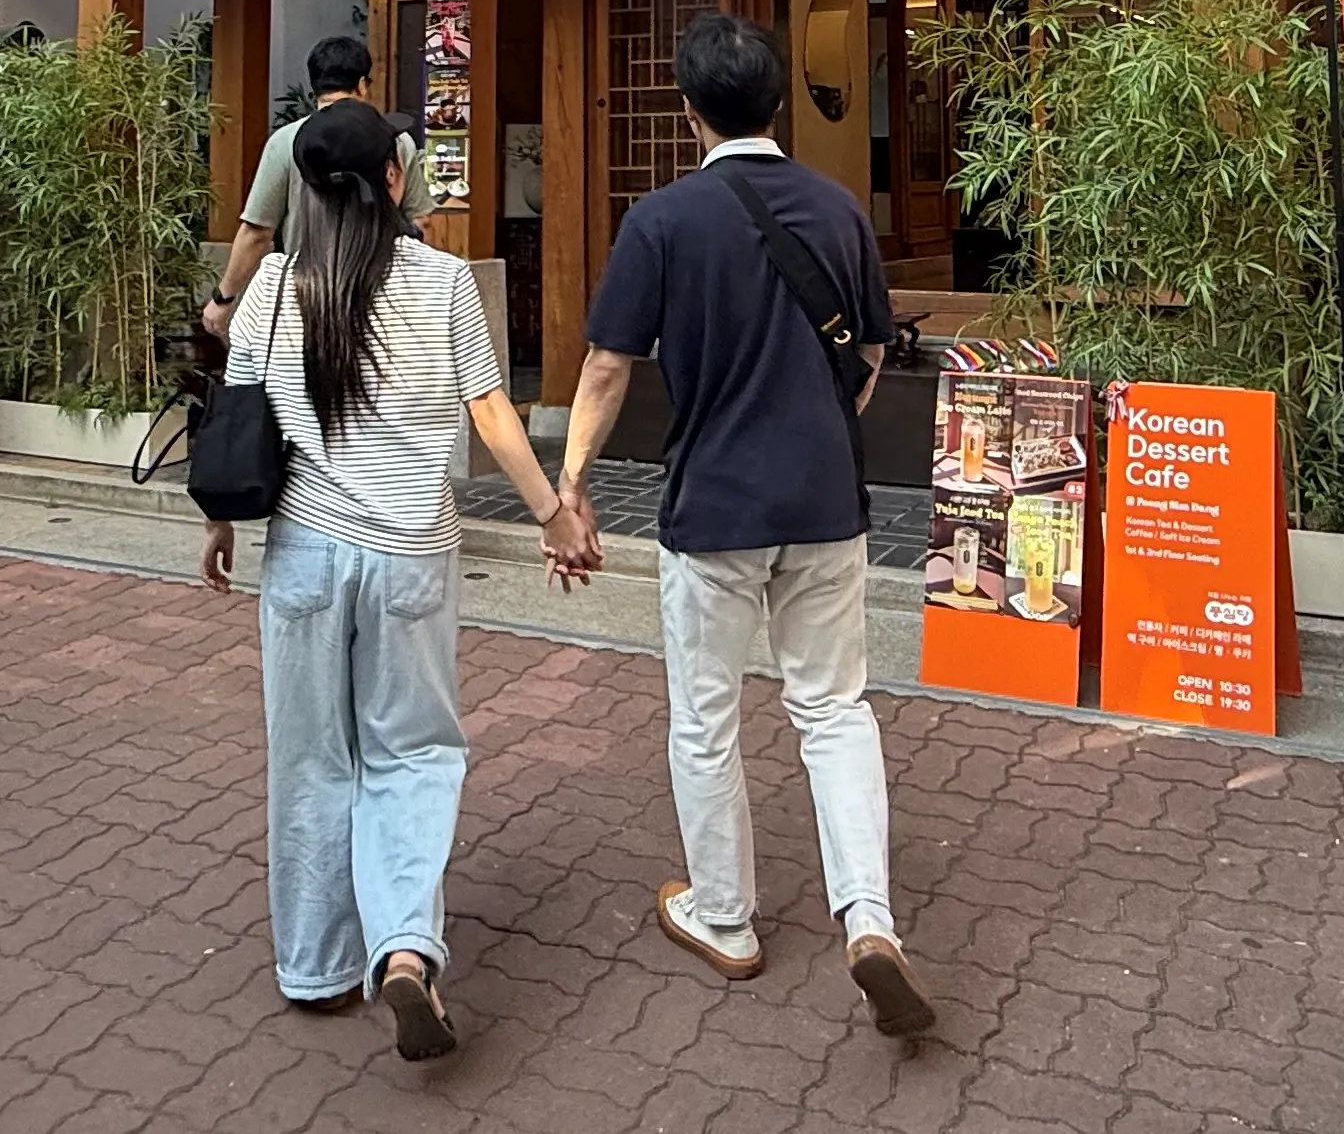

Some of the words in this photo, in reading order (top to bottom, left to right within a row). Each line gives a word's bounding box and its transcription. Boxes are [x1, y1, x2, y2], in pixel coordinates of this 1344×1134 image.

[1128, 407, 1225, 437] Korean
[1127, 434, 1230, 466] Dessert
[1125, 461, 1191, 490] Cafe
[985, 508, 1005, 521] Tea
[1125, 516, 1156, 527] Korean
[1156, 517, 1172, 529] Tea
[1173, 520, 1180, 529] &
[1181, 521, 1214, 533] Dessert
[1125, 527, 1154, 539] Coffee
[1160, 530, 1178, 542] Soft
[1192, 534, 1221, 546] Cream
[1209, 605, 1250, 622] 풍심당
[1162, 638, 1207, 655] 아이스크림
[1177, 674, 1213, 691] OPEN
[1220, 680, 1251, 696] 10:30
[1173, 690, 1214, 706] CLOSE
[1220, 696, 1251, 712] 19:30
